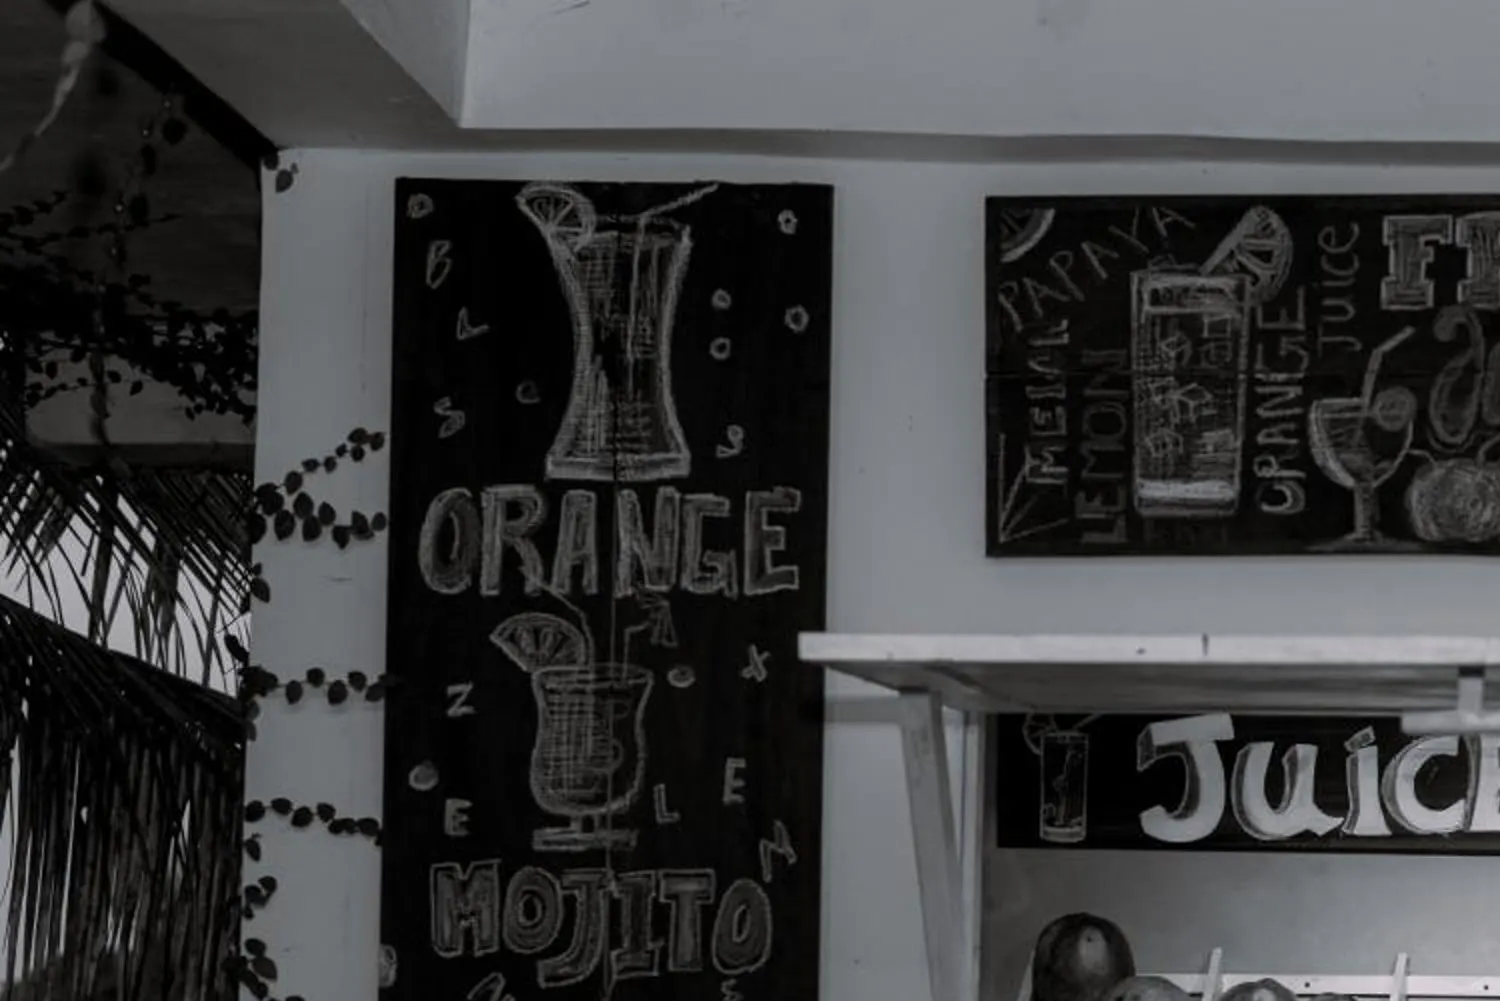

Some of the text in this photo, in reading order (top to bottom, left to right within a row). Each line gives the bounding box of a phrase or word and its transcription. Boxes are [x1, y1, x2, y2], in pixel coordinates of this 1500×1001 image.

[998, 206, 1197, 333] PAPAYA
[1073, 348, 1129, 544] LEMON
[1252, 285, 1309, 515] ORANGE
[418, 483, 802, 599] ORANGE
[429, 859, 774, 989] MOJITO
